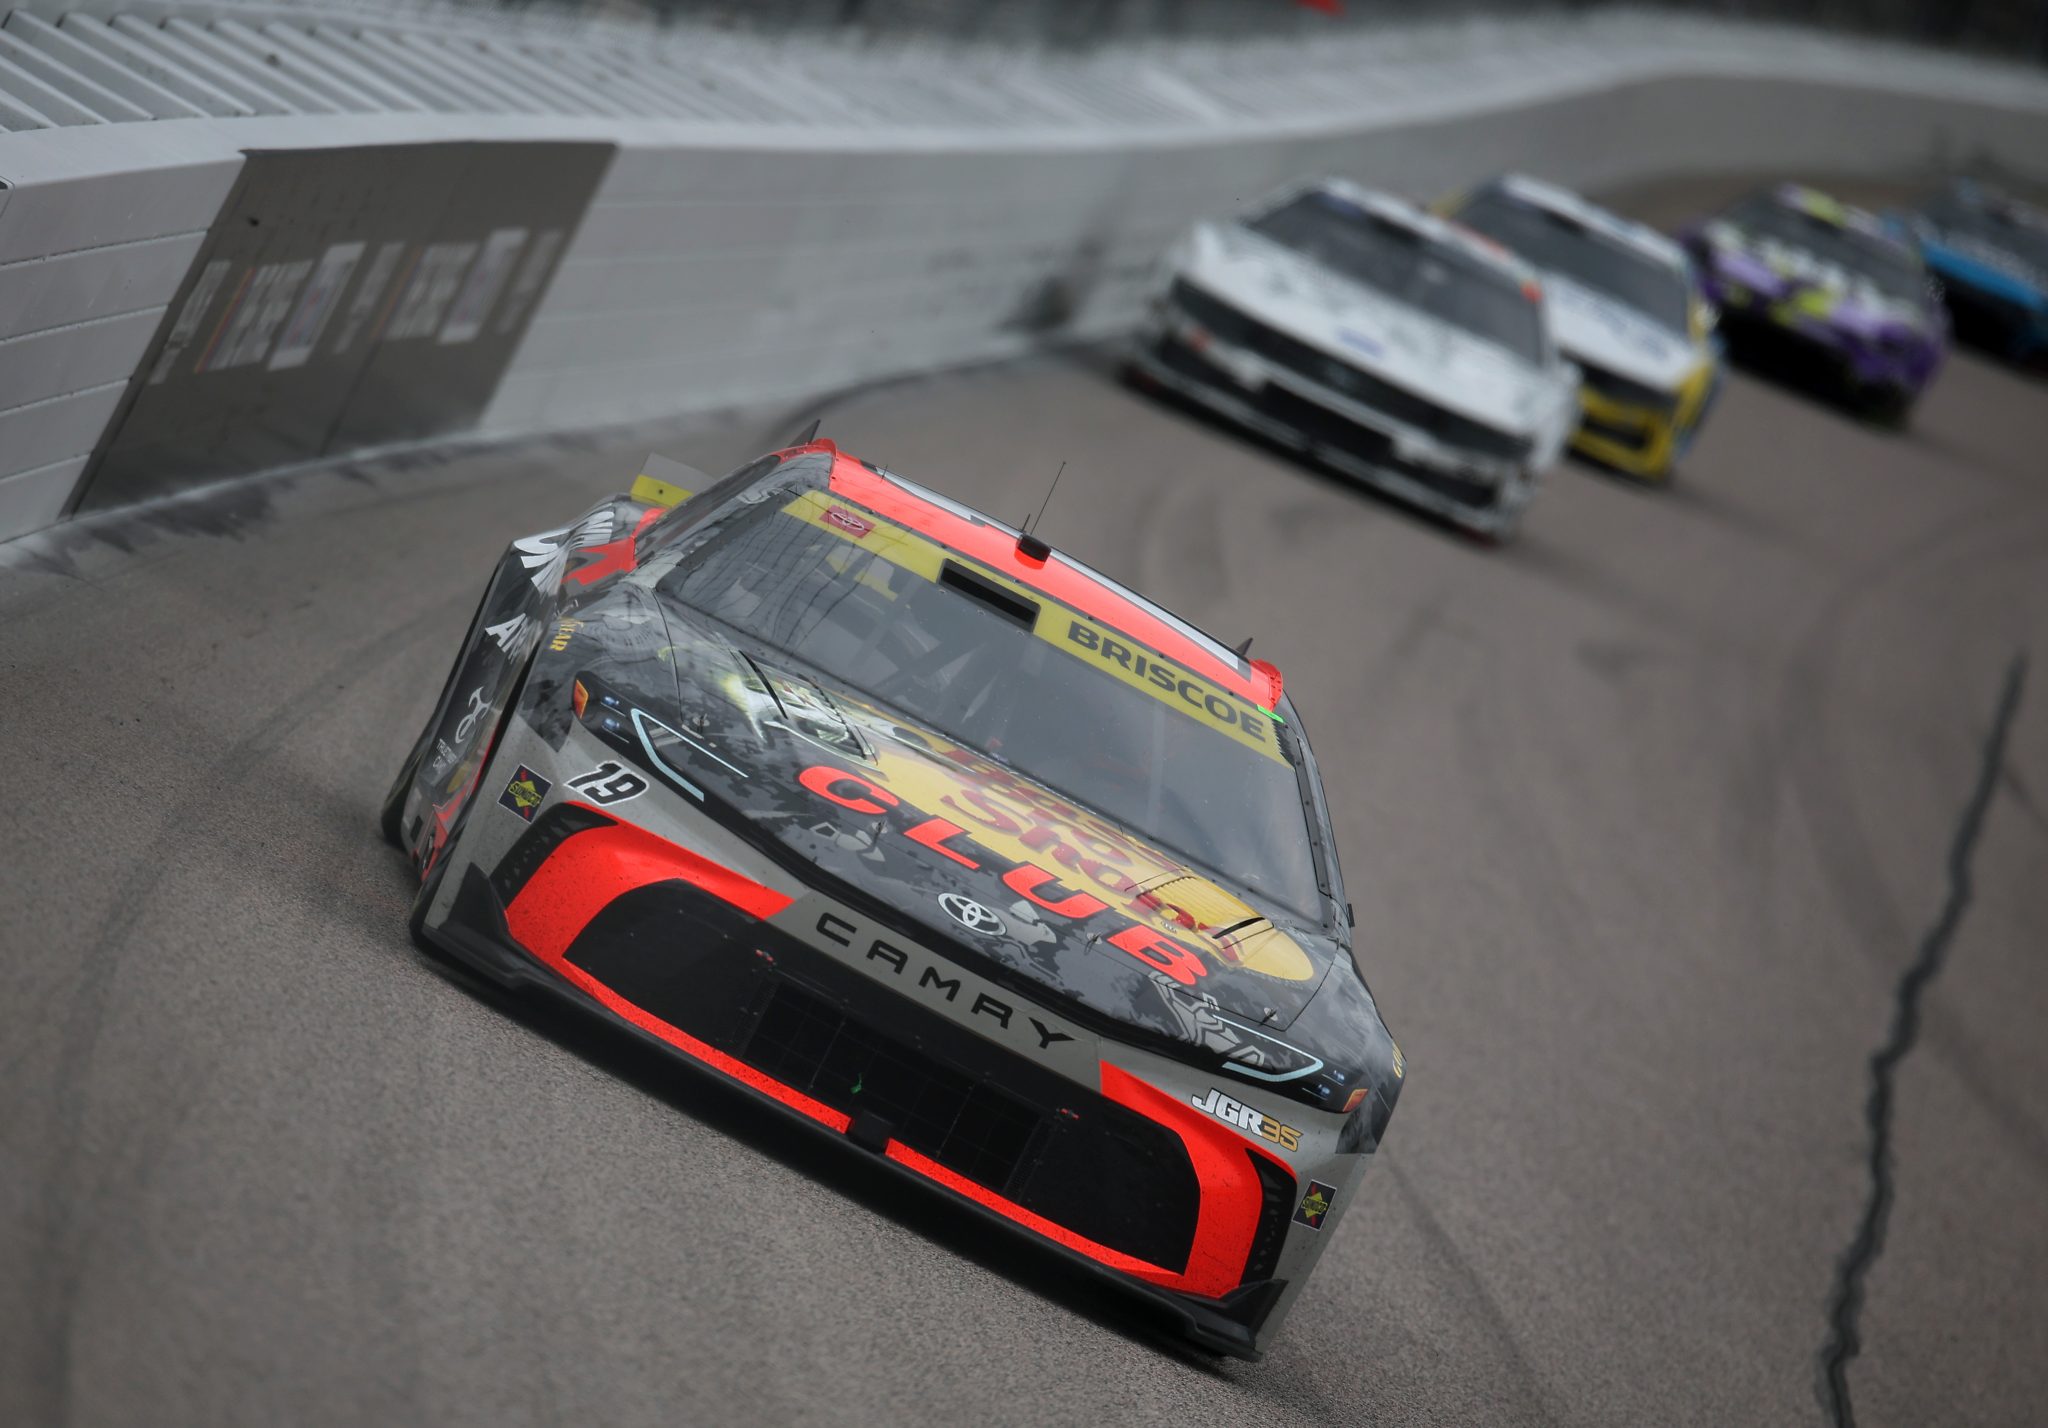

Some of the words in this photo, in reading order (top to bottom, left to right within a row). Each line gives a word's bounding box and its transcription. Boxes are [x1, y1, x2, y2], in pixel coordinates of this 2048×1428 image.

[1068, 620, 1266, 742] BRISCOE
[564, 761, 650, 806] 19
[799, 765, 1207, 985] CLUB
[939, 787, 1244, 966] Shops
[816, 912, 1075, 1050] CAMRY
